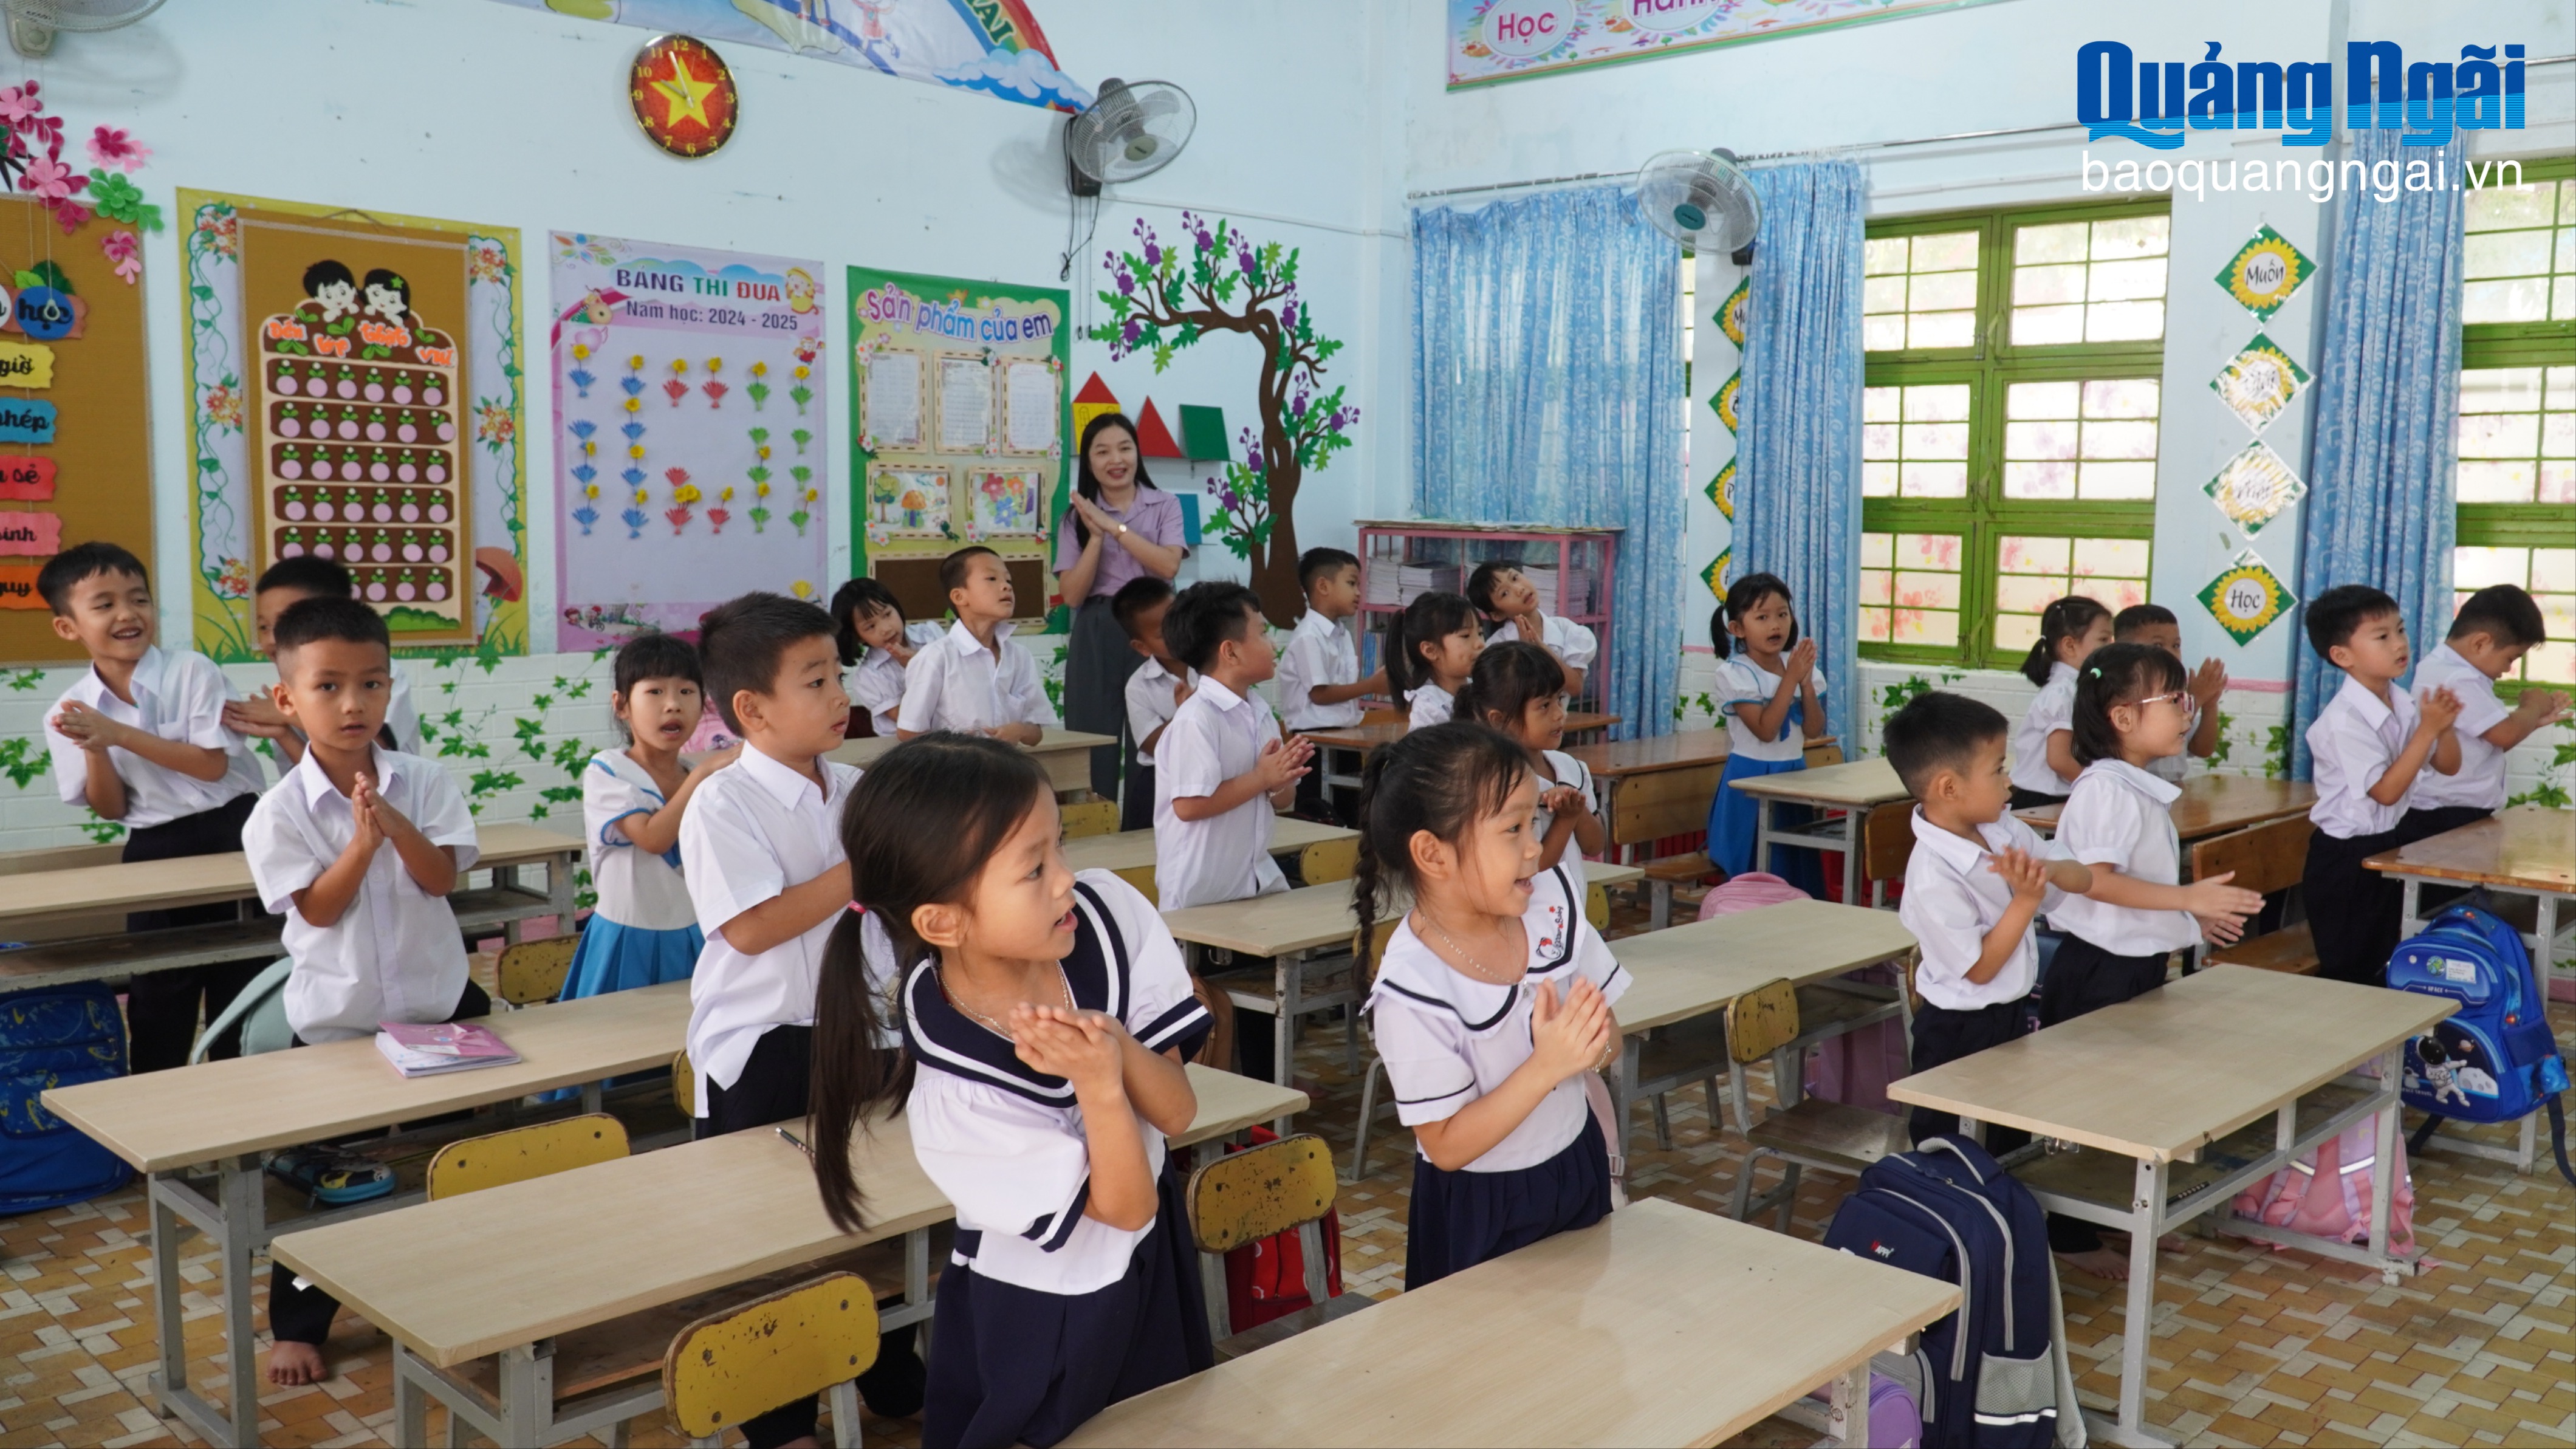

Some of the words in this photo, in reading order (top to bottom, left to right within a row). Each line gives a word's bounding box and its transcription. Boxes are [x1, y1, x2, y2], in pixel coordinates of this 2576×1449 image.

[1498, 12, 1555, 45] Học
[672, 39, 689, 50] 12
[651, 47, 663, 58] 11
[702, 49, 707, 60] 1
[637, 66, 652, 77] 10
[717, 69, 726, 80] 2
[634, 89, 644, 100] 9
[725, 92, 735, 103] 3
[645, 116, 654, 127] 8
[722, 118, 731, 128] 4
[664, 135, 673, 146] 7
[709, 136, 717, 147] 5
[686, 143, 696, 154] 6
[2247, 259, 2284, 285] Muốn
[617, 265, 683, 292] BẢNG
[693, 276, 728, 296] THI
[737, 281, 781, 301] ĐUA
[19, 298, 73, 331] học
[670, 304, 703, 324] học:
[709, 307, 745, 325] 2024
[762, 313, 798, 330] 2025
[866, 283, 911, 322] Sản
[916, 299, 975, 340] phẩm
[980, 307, 1018, 341] của
[1023, 313, 1053, 340] em
[2231, 589, 2260, 612] Học
